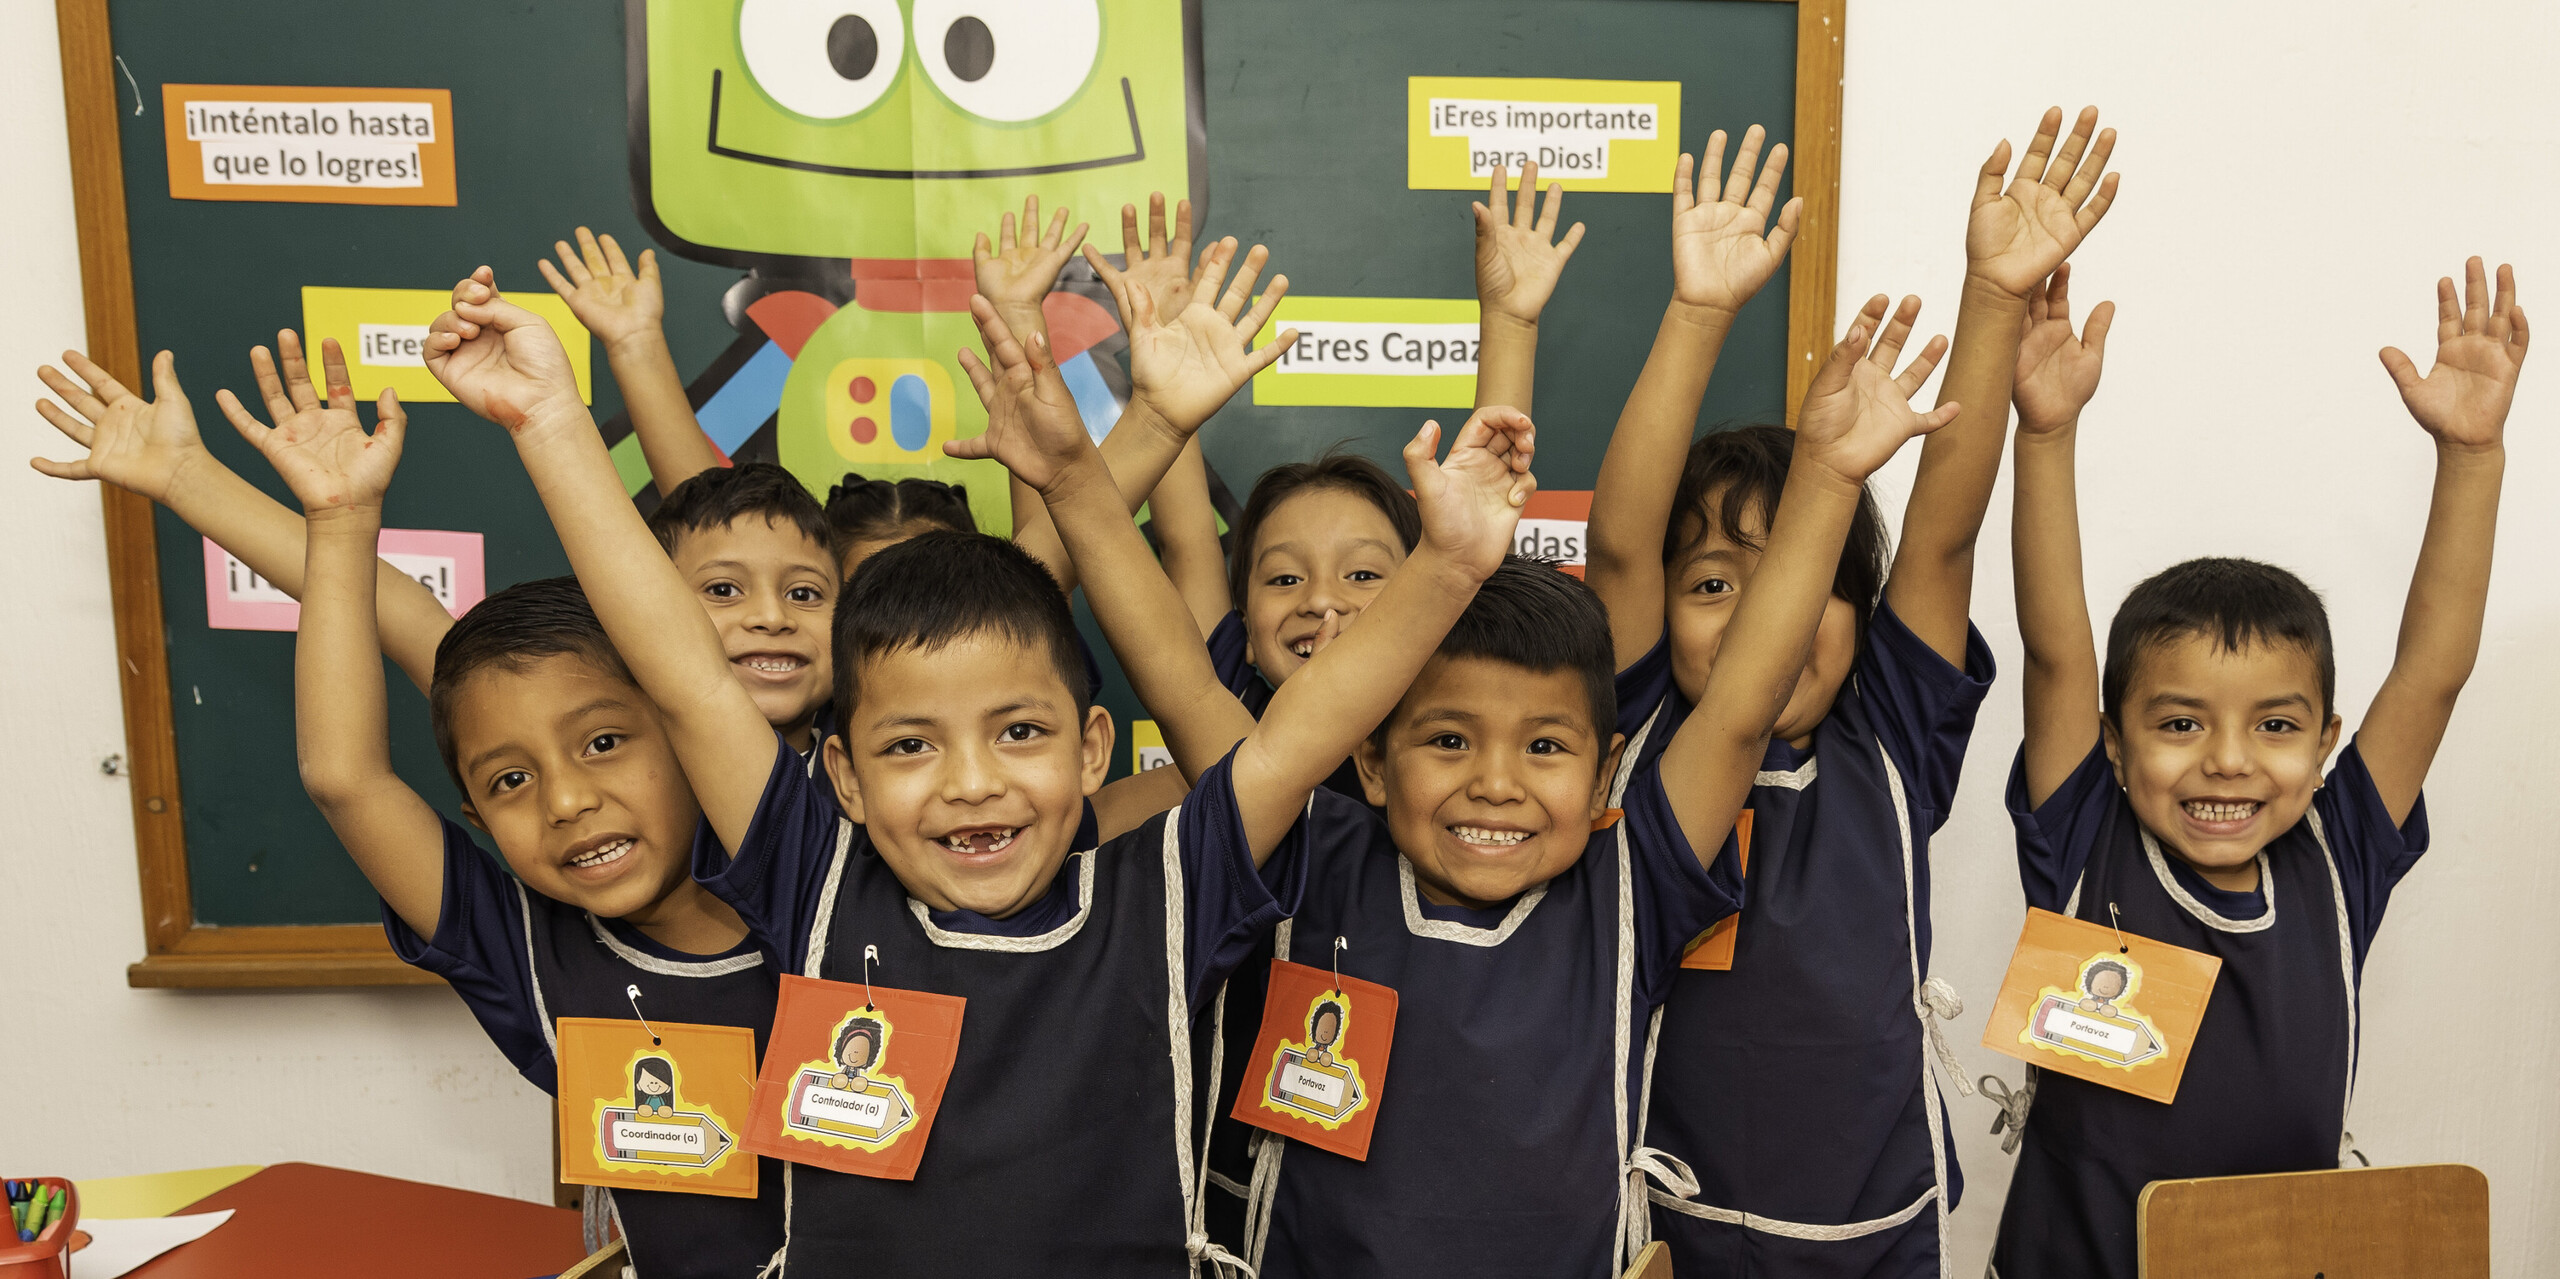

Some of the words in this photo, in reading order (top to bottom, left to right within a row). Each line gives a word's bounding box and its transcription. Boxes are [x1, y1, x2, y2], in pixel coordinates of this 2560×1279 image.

[187, 107, 339, 136] ¡Inténtalo
[349, 108, 430, 136] hasta
[1434, 105, 1498, 129] ¡Eres
[1506, 106, 1652, 133] importante
[213, 154, 269, 180] que
[280, 149, 306, 176] lo
[317, 150, 419, 183] logres!
[1472, 150, 1528, 172] para
[1538, 146, 1603, 170] Dios!
[1382, 332, 1480, 370] Capaz
[2069, 1019, 2110, 1040] Portavoz
[1298, 1074, 1326, 1092] Portavoz
[811, 1093, 864, 1112] Controlador
[865, 1102, 880, 1116] (a)
[620, 1128, 681, 1142] Coordinador
[683, 1132, 698, 1145] (a)
